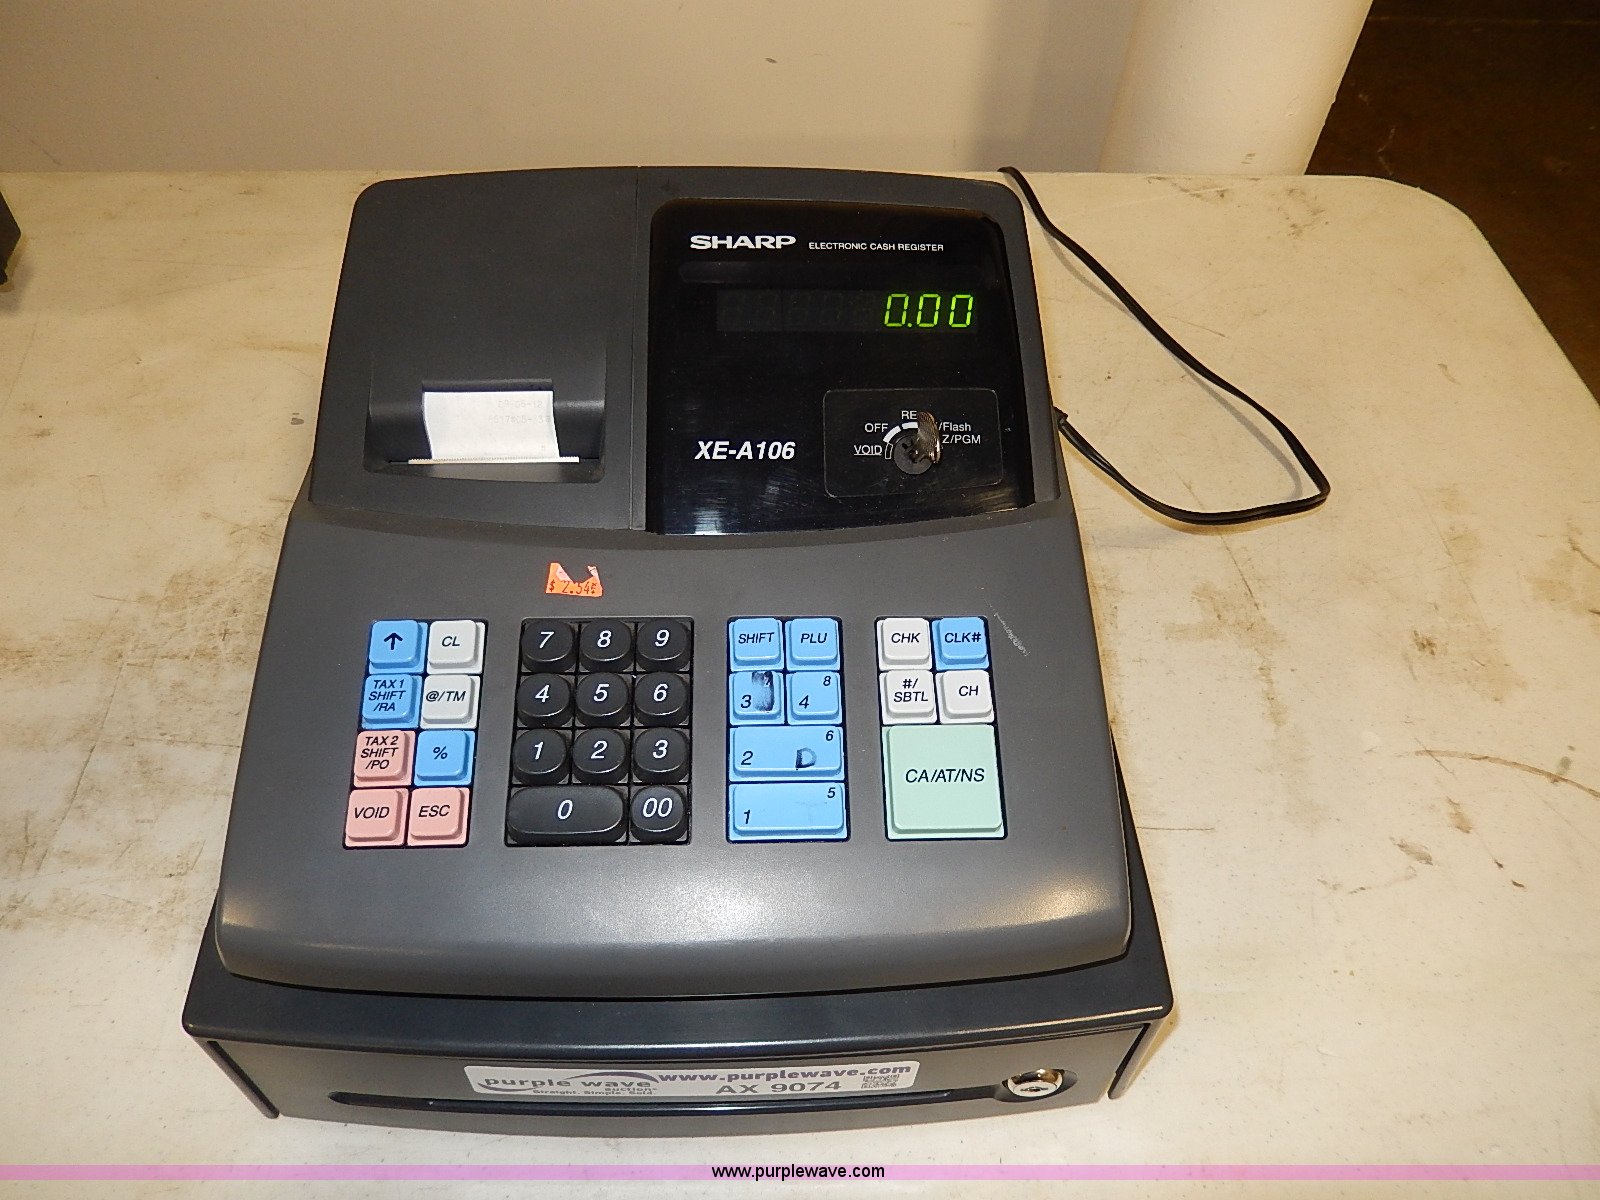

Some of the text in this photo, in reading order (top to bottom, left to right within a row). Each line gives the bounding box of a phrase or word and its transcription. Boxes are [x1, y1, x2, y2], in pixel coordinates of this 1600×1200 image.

[689, 235, 797, 250] SHARP
[808, 241, 944, 252] ELECTRONIC CASH REGISTER
[884, 293, 974, 328] 0.00
[901, 410, 917, 420] RE
[864, 422, 889, 433] OFF
[938, 420, 972, 432] /Flash
[942, 434, 981, 444] Z/PGM
[694, 440, 796, 460] XE-A106
[853, 444, 883, 456] VOID
[441, 635, 461, 647] CL
[539, 631, 555, 649] 7
[596, 629, 612, 648] 8
[654, 629, 670, 647] 9
[738, 631, 775, 645] SHIFT
[800, 632, 828, 644] PLU
[891, 632, 921, 644] CHK
[944, 631, 982, 644] CLK#
[373, 678, 405, 690] TAX 1
[822, 675, 832, 687] 8
[902, 677, 919, 689] #/
[368, 689, 407, 701] SHIFT
[425, 690, 467, 703] @/TM
[534, 684, 550, 703] 4
[593, 683, 610, 702] 5
[653, 683, 669, 702] 6
[893, 691, 929, 703] SBTL
[958, 685, 979, 697] CH
[372, 701, 396, 712] /RA
[740, 694, 752, 709] 3
[798, 694, 810, 710] 4
[364, 735, 399, 747] TAX 2
[825, 729, 834, 742] 6
[360, 747, 400, 759] SHIFT
[432, 745, 448, 760] %
[534, 741, 544, 760] 1
[590, 740, 608, 760] 2
[652, 739, 669, 759] 3
[365, 759, 390, 770] /PO
[740, 750, 754, 766] 2
[795, 746, 817, 770] D
[905, 767, 985, 784] CA/AT/NS
[827, 786, 836, 799] 5
[354, 806, 390, 819] VOID
[418, 804, 451, 818] ESC
[557, 799, 574, 820] 0
[642, 797, 673, 818] 00
[743, 809, 751, 825] 1
[658, 1065, 911, 1083] www.purplewave.com
[484, 1077, 652, 1088] purple wave
[715, 1080, 842, 1095] AX 9074
